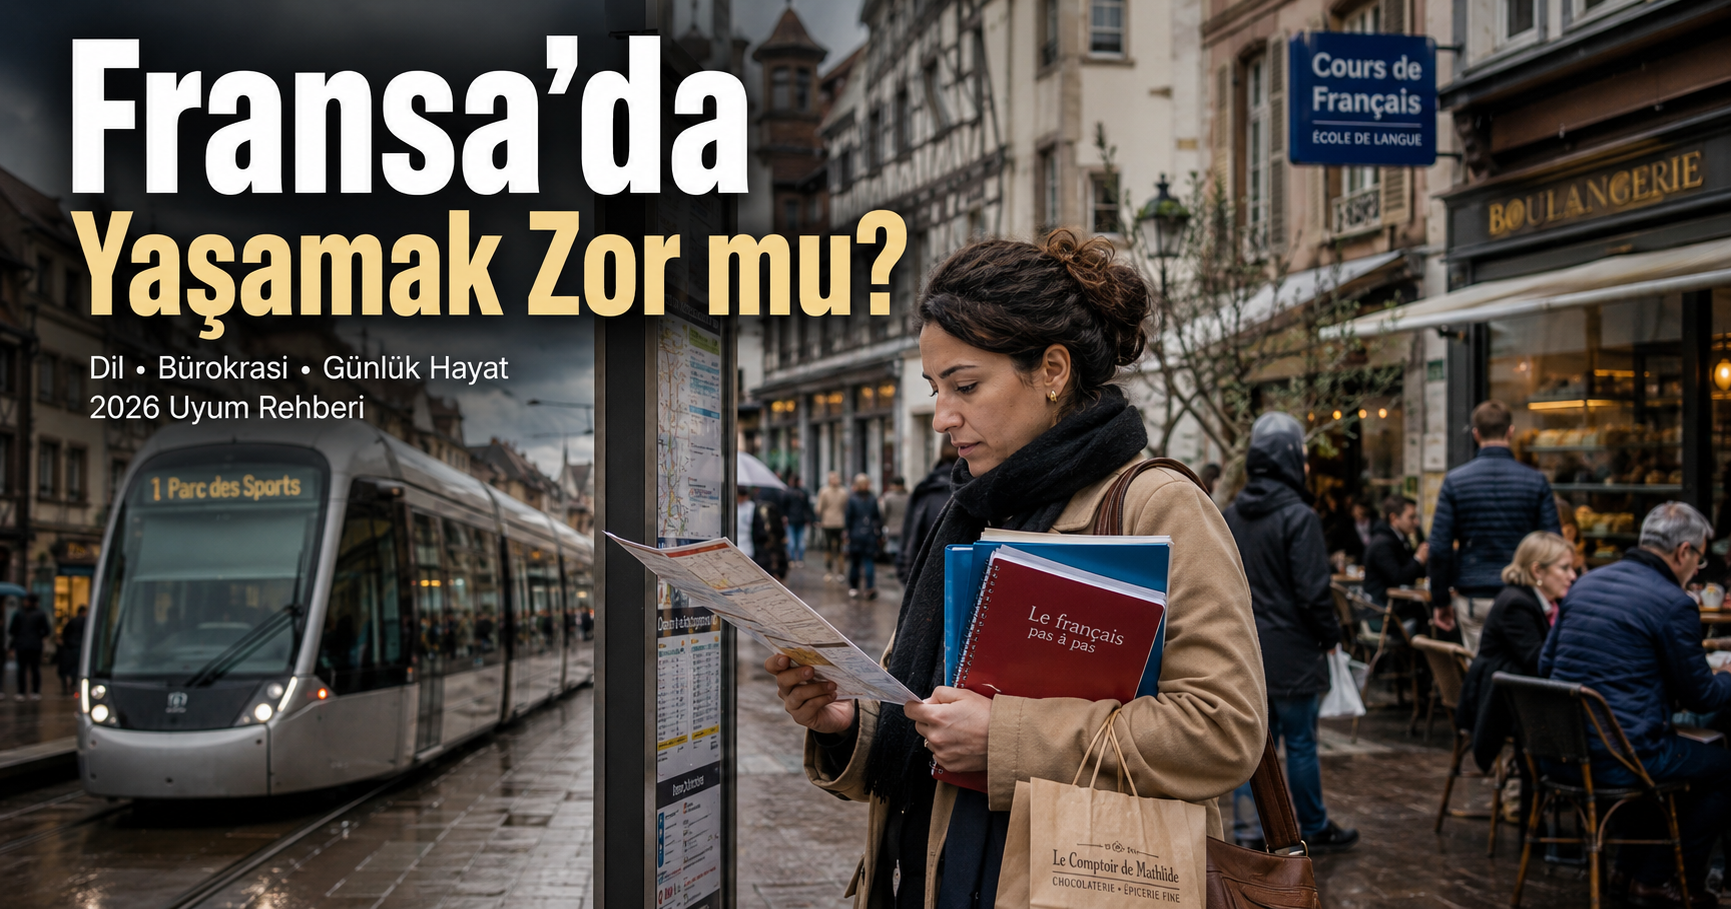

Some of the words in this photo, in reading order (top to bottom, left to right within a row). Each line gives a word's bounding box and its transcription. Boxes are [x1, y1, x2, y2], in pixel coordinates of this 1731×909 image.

[1312, 52, 1387, 79] Cours
[1392, 54, 1422, 80] de
[1312, 86, 1422, 120] Français
[1312, 129, 1351, 144] ÉCOLE
[1354, 132, 1371, 145] DE
[1374, 133, 1422, 146] LANGUE
[1488, 151, 1704, 236] BOULANGERIE
[150, 477, 161, 501] 1
[167, 477, 207, 499] Parc
[209, 475, 241, 498] des
[243, 474, 301, 501] Sports
[1028, 605, 1050, 625] Le
[1055, 613, 1124, 646] français
[1027, 627, 1054, 642] pas
[1069, 639, 1096, 653] pas
[1053, 849, 1066, 867] Le
[1069, 851, 1119, 875] Comptoir
[1121, 859, 1134, 876] de
[1052, 876, 1115, 893] CHOCOLATERIE
[1162, 891, 1180, 903] FINE
